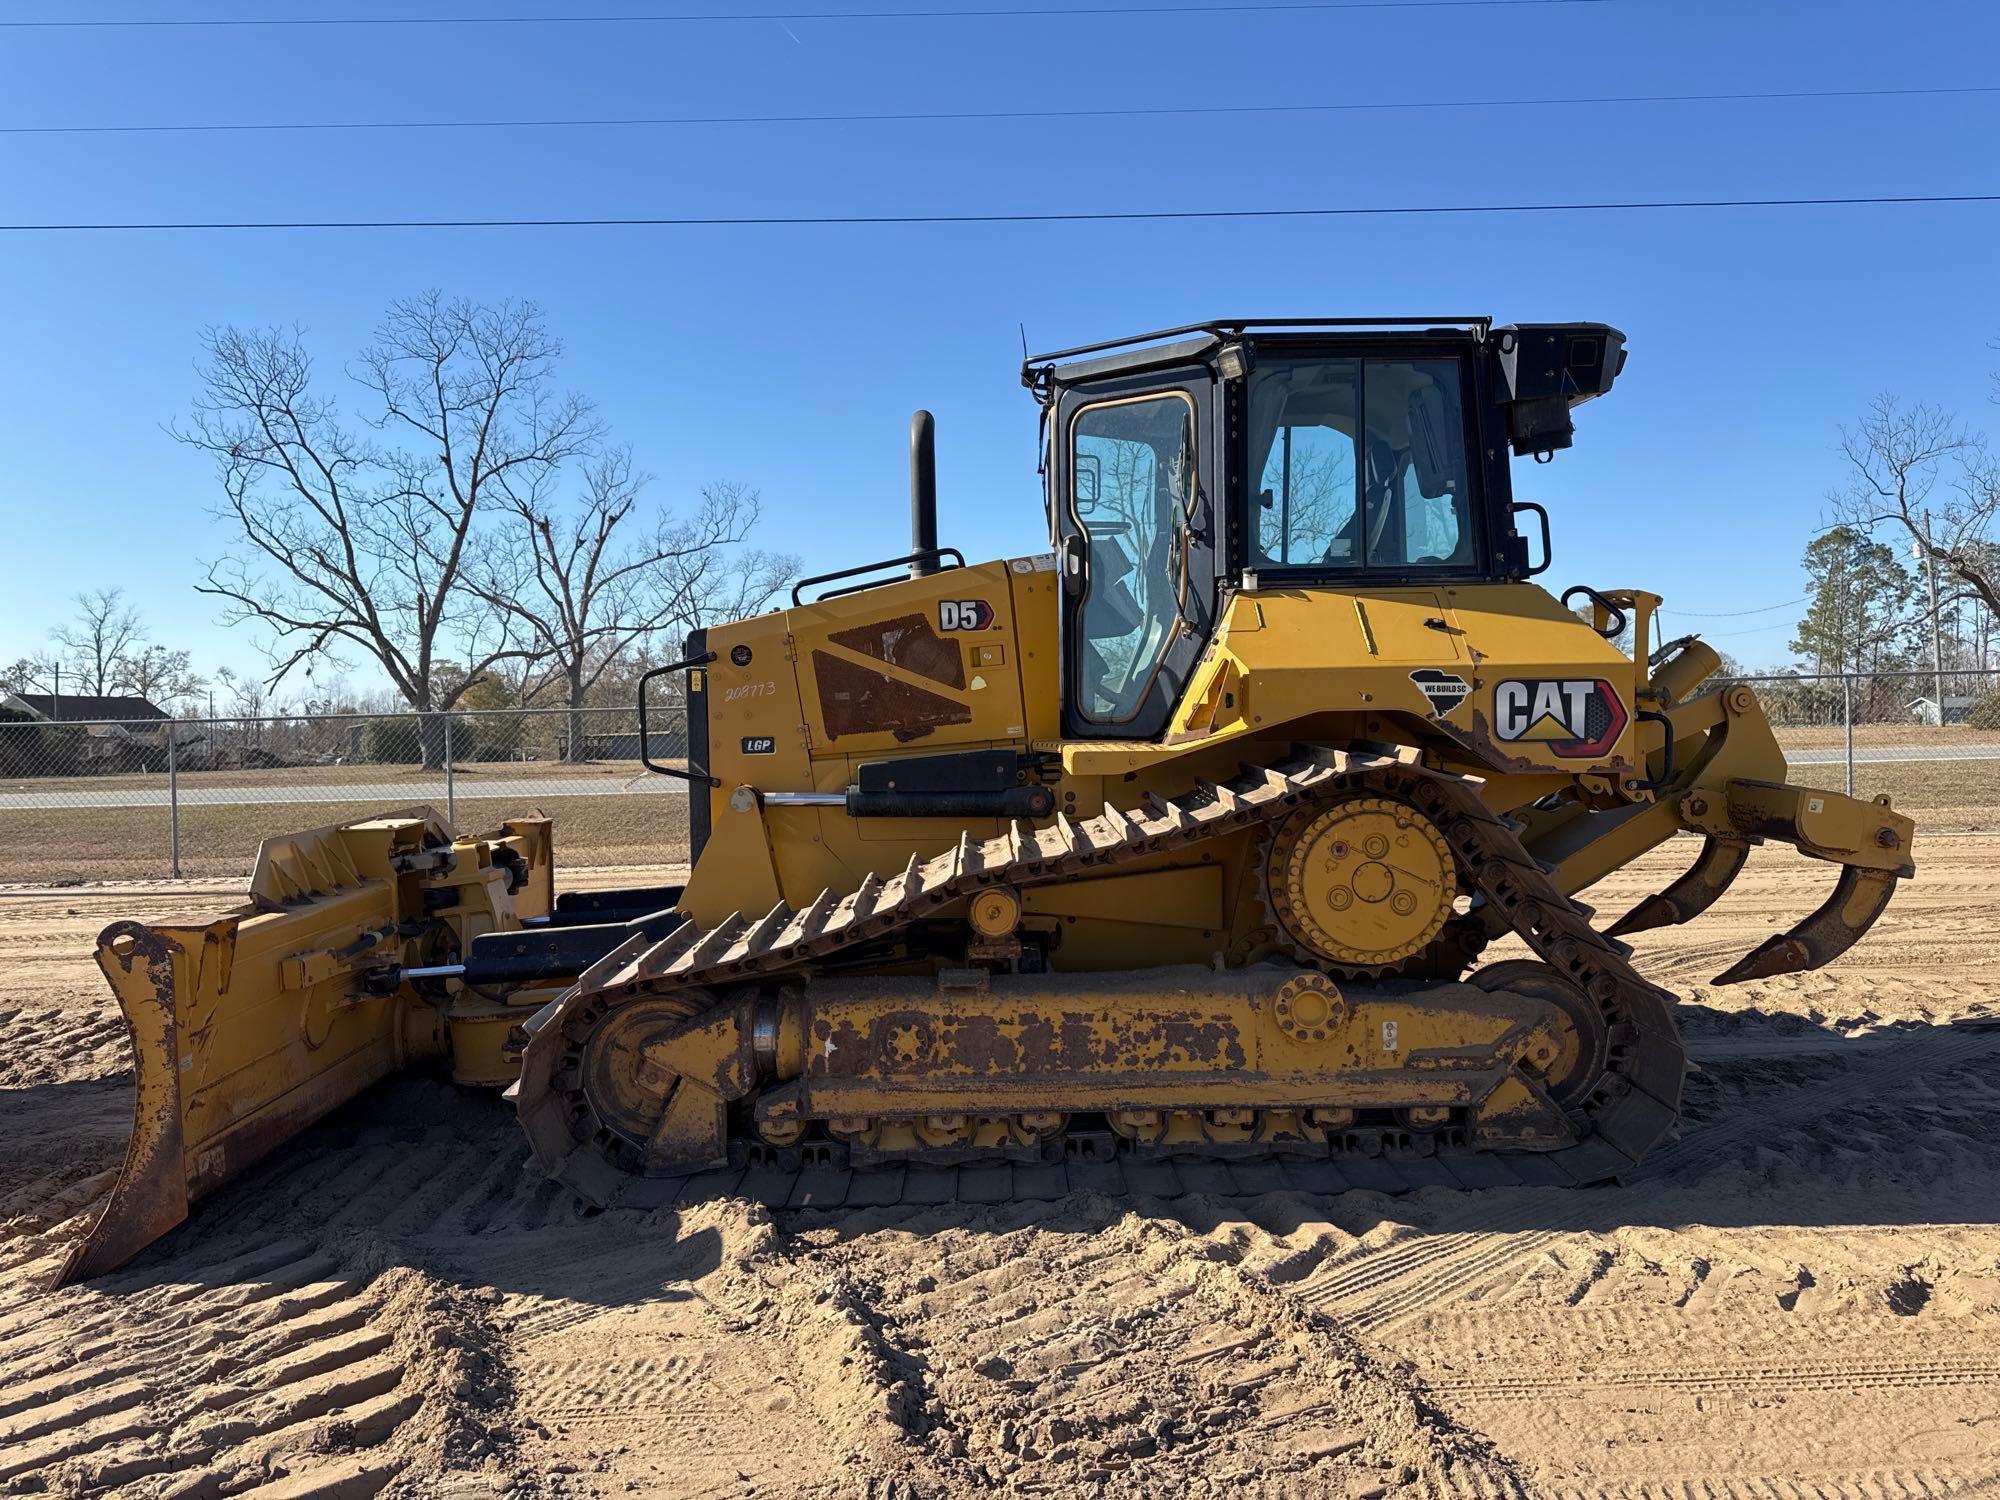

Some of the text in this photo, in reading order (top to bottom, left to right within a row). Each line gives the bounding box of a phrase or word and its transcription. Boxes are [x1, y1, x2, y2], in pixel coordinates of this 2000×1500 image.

[941, 602, 977, 630] D5
[725, 681, 776, 702] 208773
[1425, 685, 1466, 693] WE BUILD SC
[1496, 681, 1594, 740] CAT
[747, 740, 771, 751] LGP
